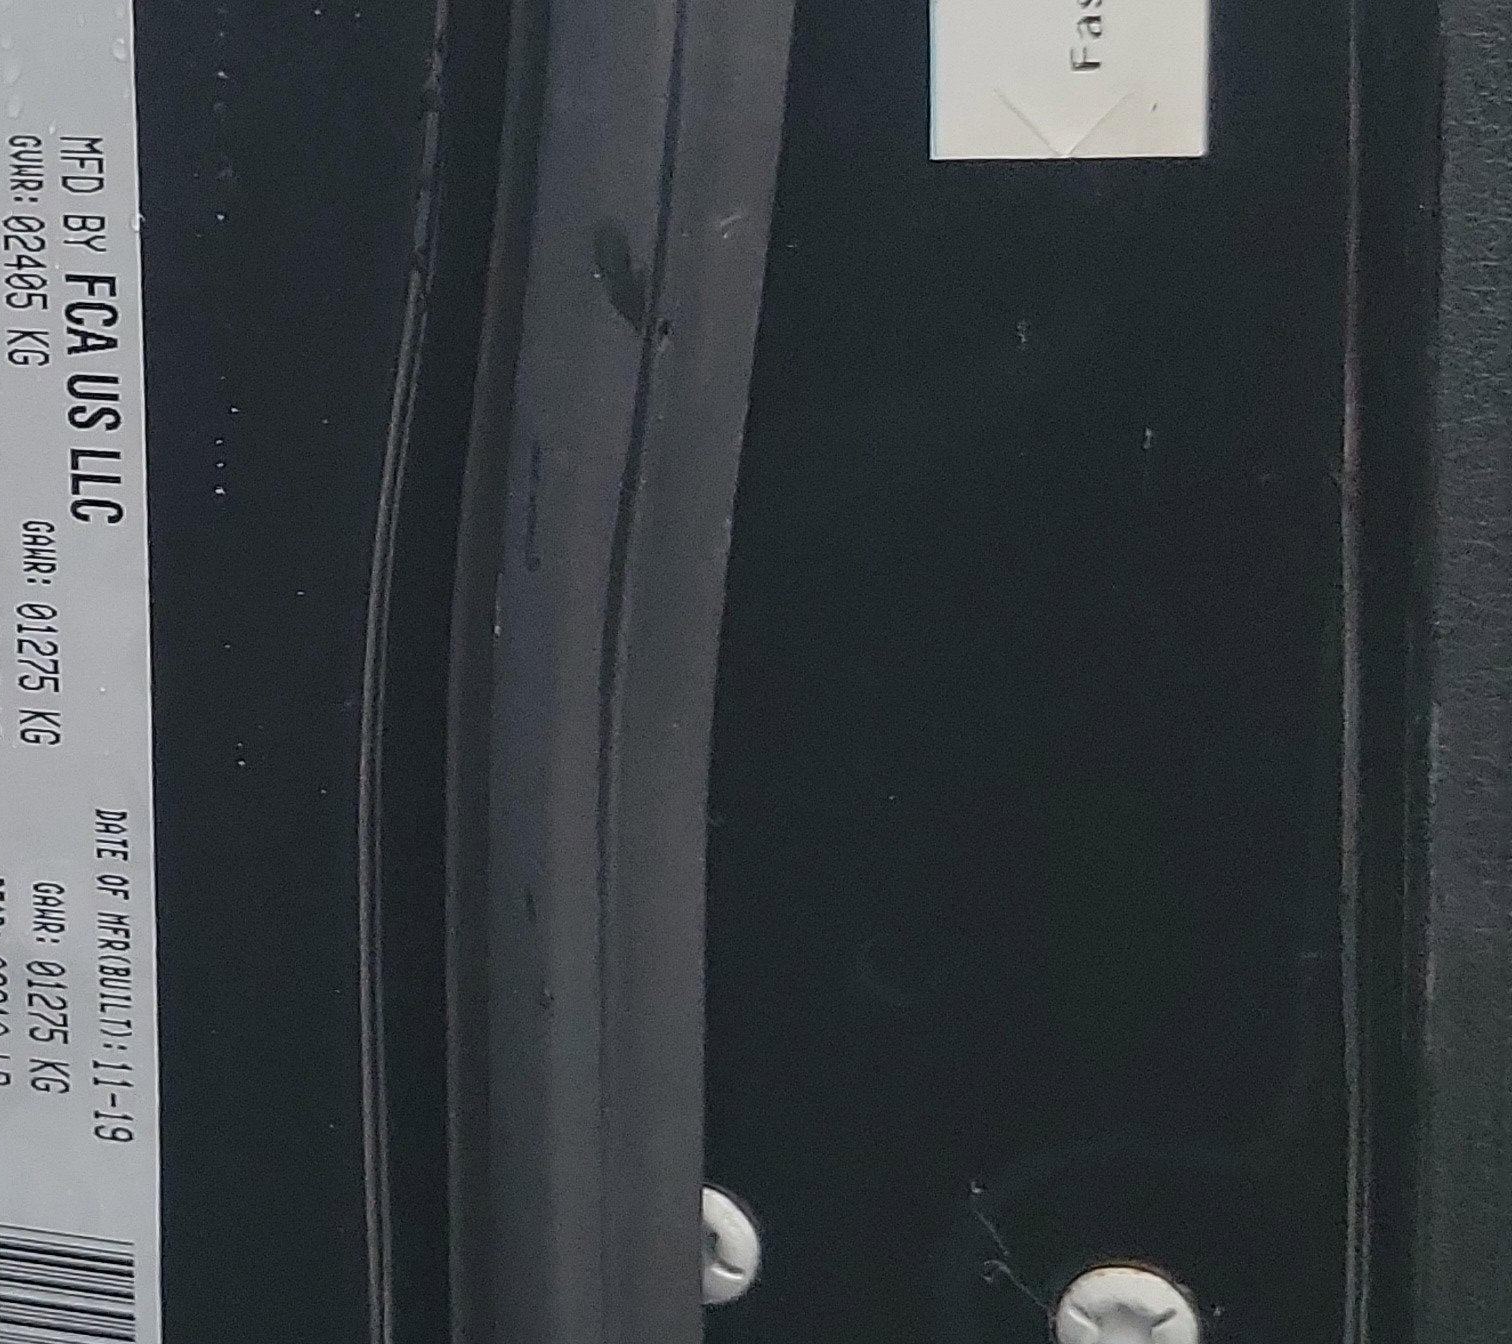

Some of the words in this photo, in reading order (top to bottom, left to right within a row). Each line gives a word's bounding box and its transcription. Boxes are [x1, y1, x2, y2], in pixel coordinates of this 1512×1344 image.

[9, 136, 44, 202] GVWR:
[60, 137, 104, 193] MFD
[2, 216, 47, 309] 02405
[63, 215, 106, 251] BY
[65, 274, 118, 355] FCA
[7, 330, 49, 366] KG
[67, 375, 121, 430] US
[71, 449, 123, 523] LLC
[23, 521, 56, 584] GAWR:
[17, 604, 59, 692] 01275
[19, 710, 60, 745] KG
[95, 809, 128, 861] DATE
[33, 883, 65, 943] GAWR:
[97, 875, 129, 900] OF
[26, 961, 68, 1044] 01275
[98, 913, 132, 1050] MFR(BUILT):
[30, 1059, 69, 1093] KG
[93, 1060, 133, 1142] 11-19
